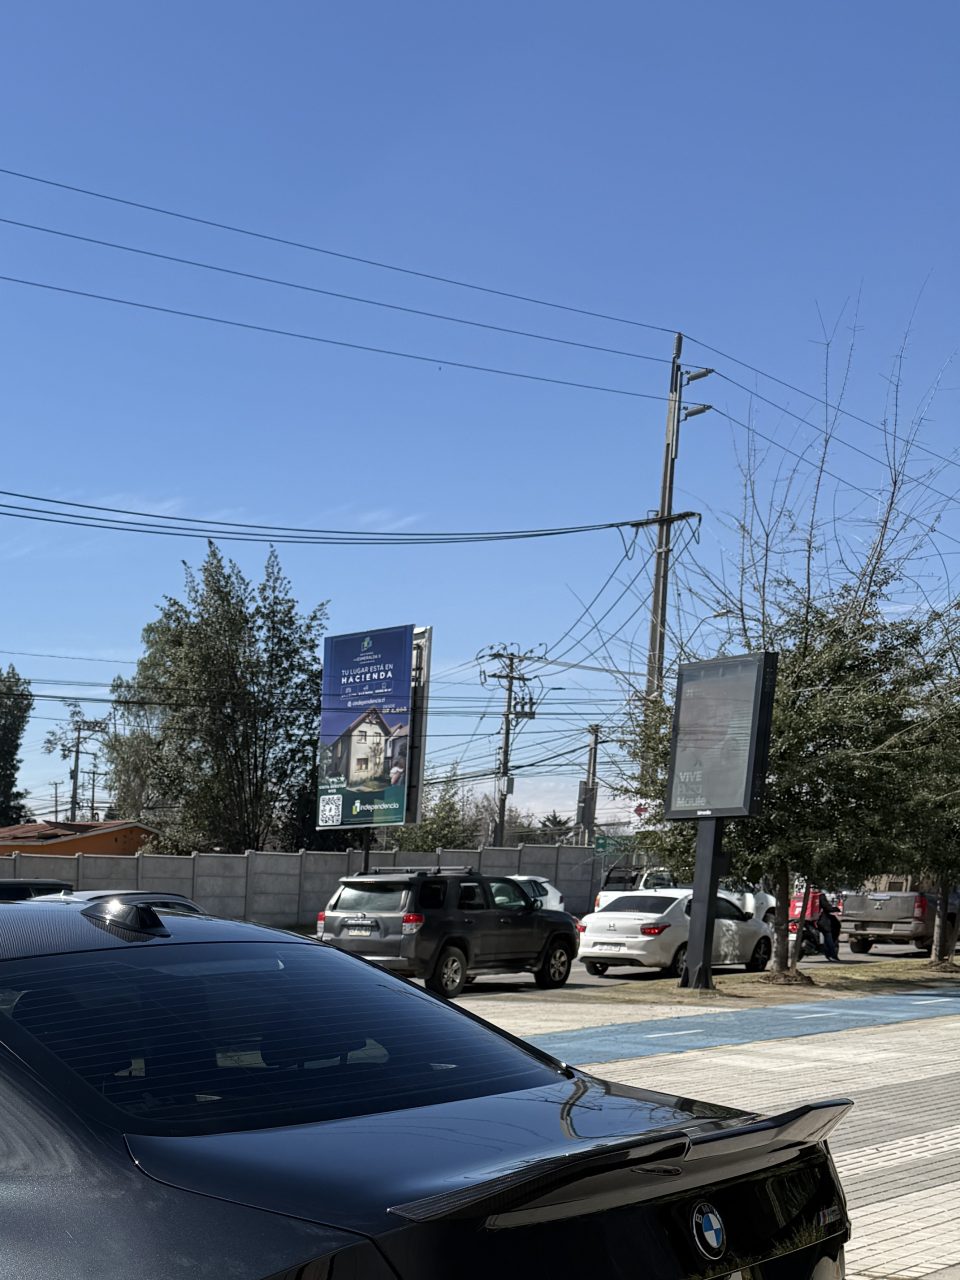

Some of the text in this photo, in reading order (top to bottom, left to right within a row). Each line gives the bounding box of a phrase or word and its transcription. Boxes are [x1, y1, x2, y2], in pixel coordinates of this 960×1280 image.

[350, 667, 369, 675] LUGAR
[369, 664, 384, 673] ESTÁ
[341, 671, 393, 684] HACIENDA
[679, 771, 703, 782] VIVE
